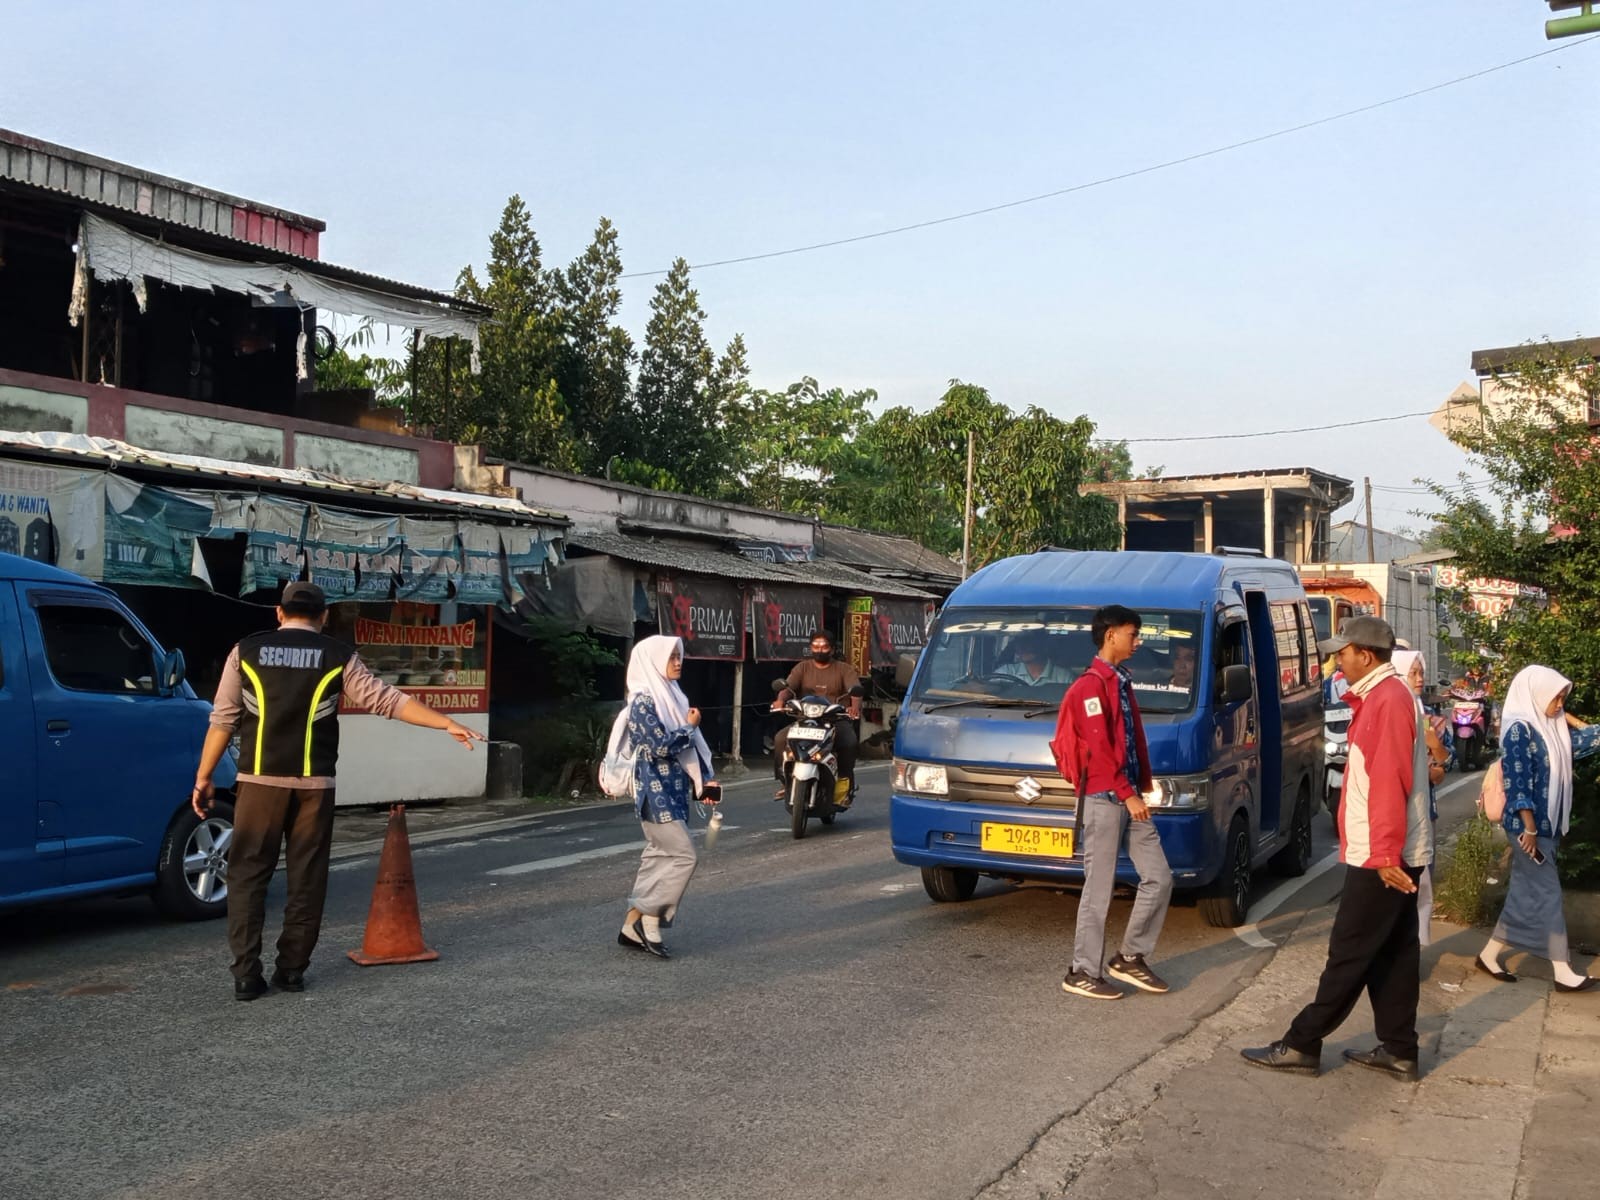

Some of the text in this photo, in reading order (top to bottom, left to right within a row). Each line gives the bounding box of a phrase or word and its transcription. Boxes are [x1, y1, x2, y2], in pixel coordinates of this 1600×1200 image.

[17, 495, 50, 515] WANITA
[689, 606, 736, 634] PRIMA
[778, 613, 818, 637] PRIMA
[887, 623, 922, 645] PRIMA
[258, 646, 323, 669] SECURITY
[425, 693, 479, 708] PADANG
[985, 826, 993, 841] F
[1051, 831, 1070, 848] PM
